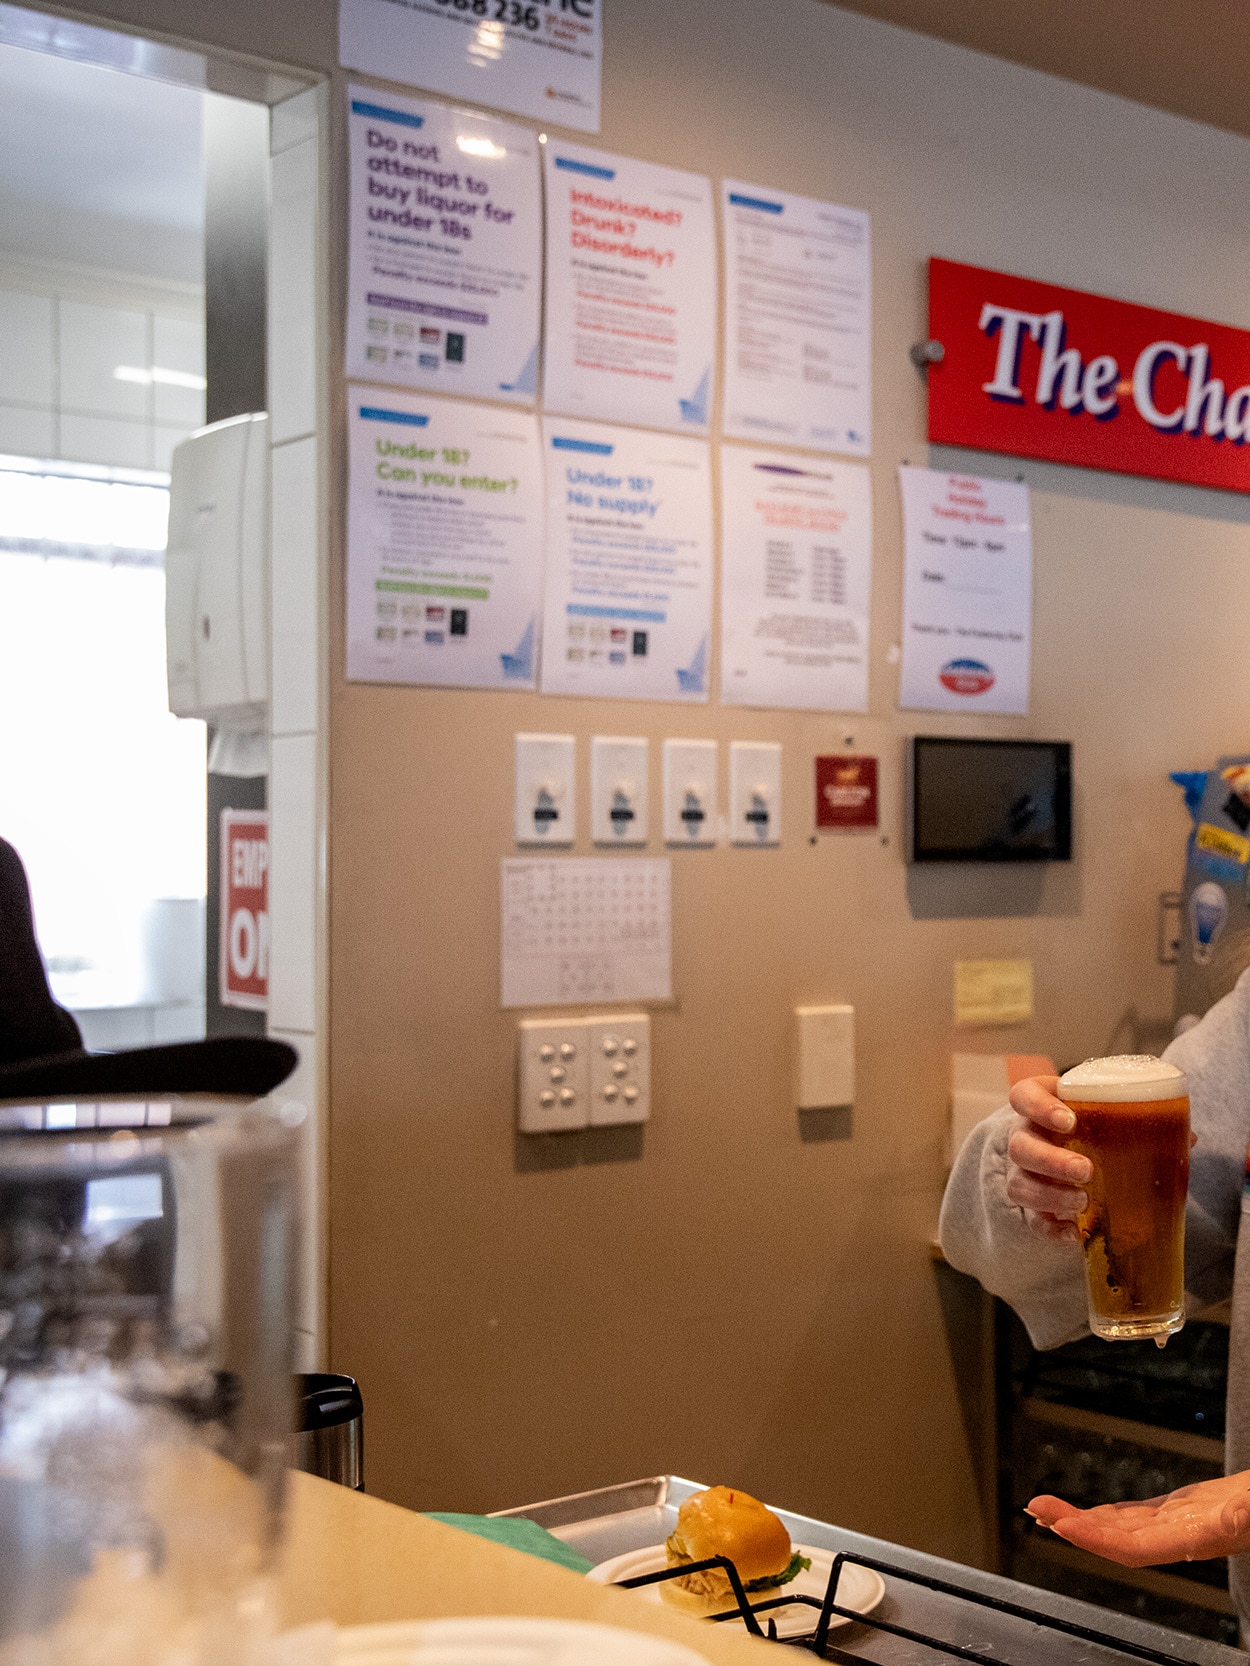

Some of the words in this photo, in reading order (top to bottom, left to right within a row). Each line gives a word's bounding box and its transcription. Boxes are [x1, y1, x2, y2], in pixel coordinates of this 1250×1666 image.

[496, 0, 541, 31] 236
[366, 128, 398, 153] Do
[404, 141, 440, 162] not
[367, 157, 461, 191] attempt
[465, 174, 489, 197] to
[368, 177, 411, 204] buy
[416, 186, 478, 216] liquor
[484, 202, 515, 225] for
[570, 187, 683, 228] Intoxicated?
[368, 206, 434, 232] under
[440, 215, 473, 241] 18s
[570, 209, 638, 236] Drunk?
[570, 230, 676, 268] Disorderly?
[978, 301, 1119, 421] The
[375, 438, 437, 462] Under
[441, 446, 472, 467] 18?
[375, 461, 417, 482] Can
[421, 470, 455, 488] you
[459, 474, 520, 495] enter?
[566, 467, 623, 489] Under
[627, 475, 655, 492] 18?
[566, 489, 593, 508] No
[597, 495, 661, 519] supply
